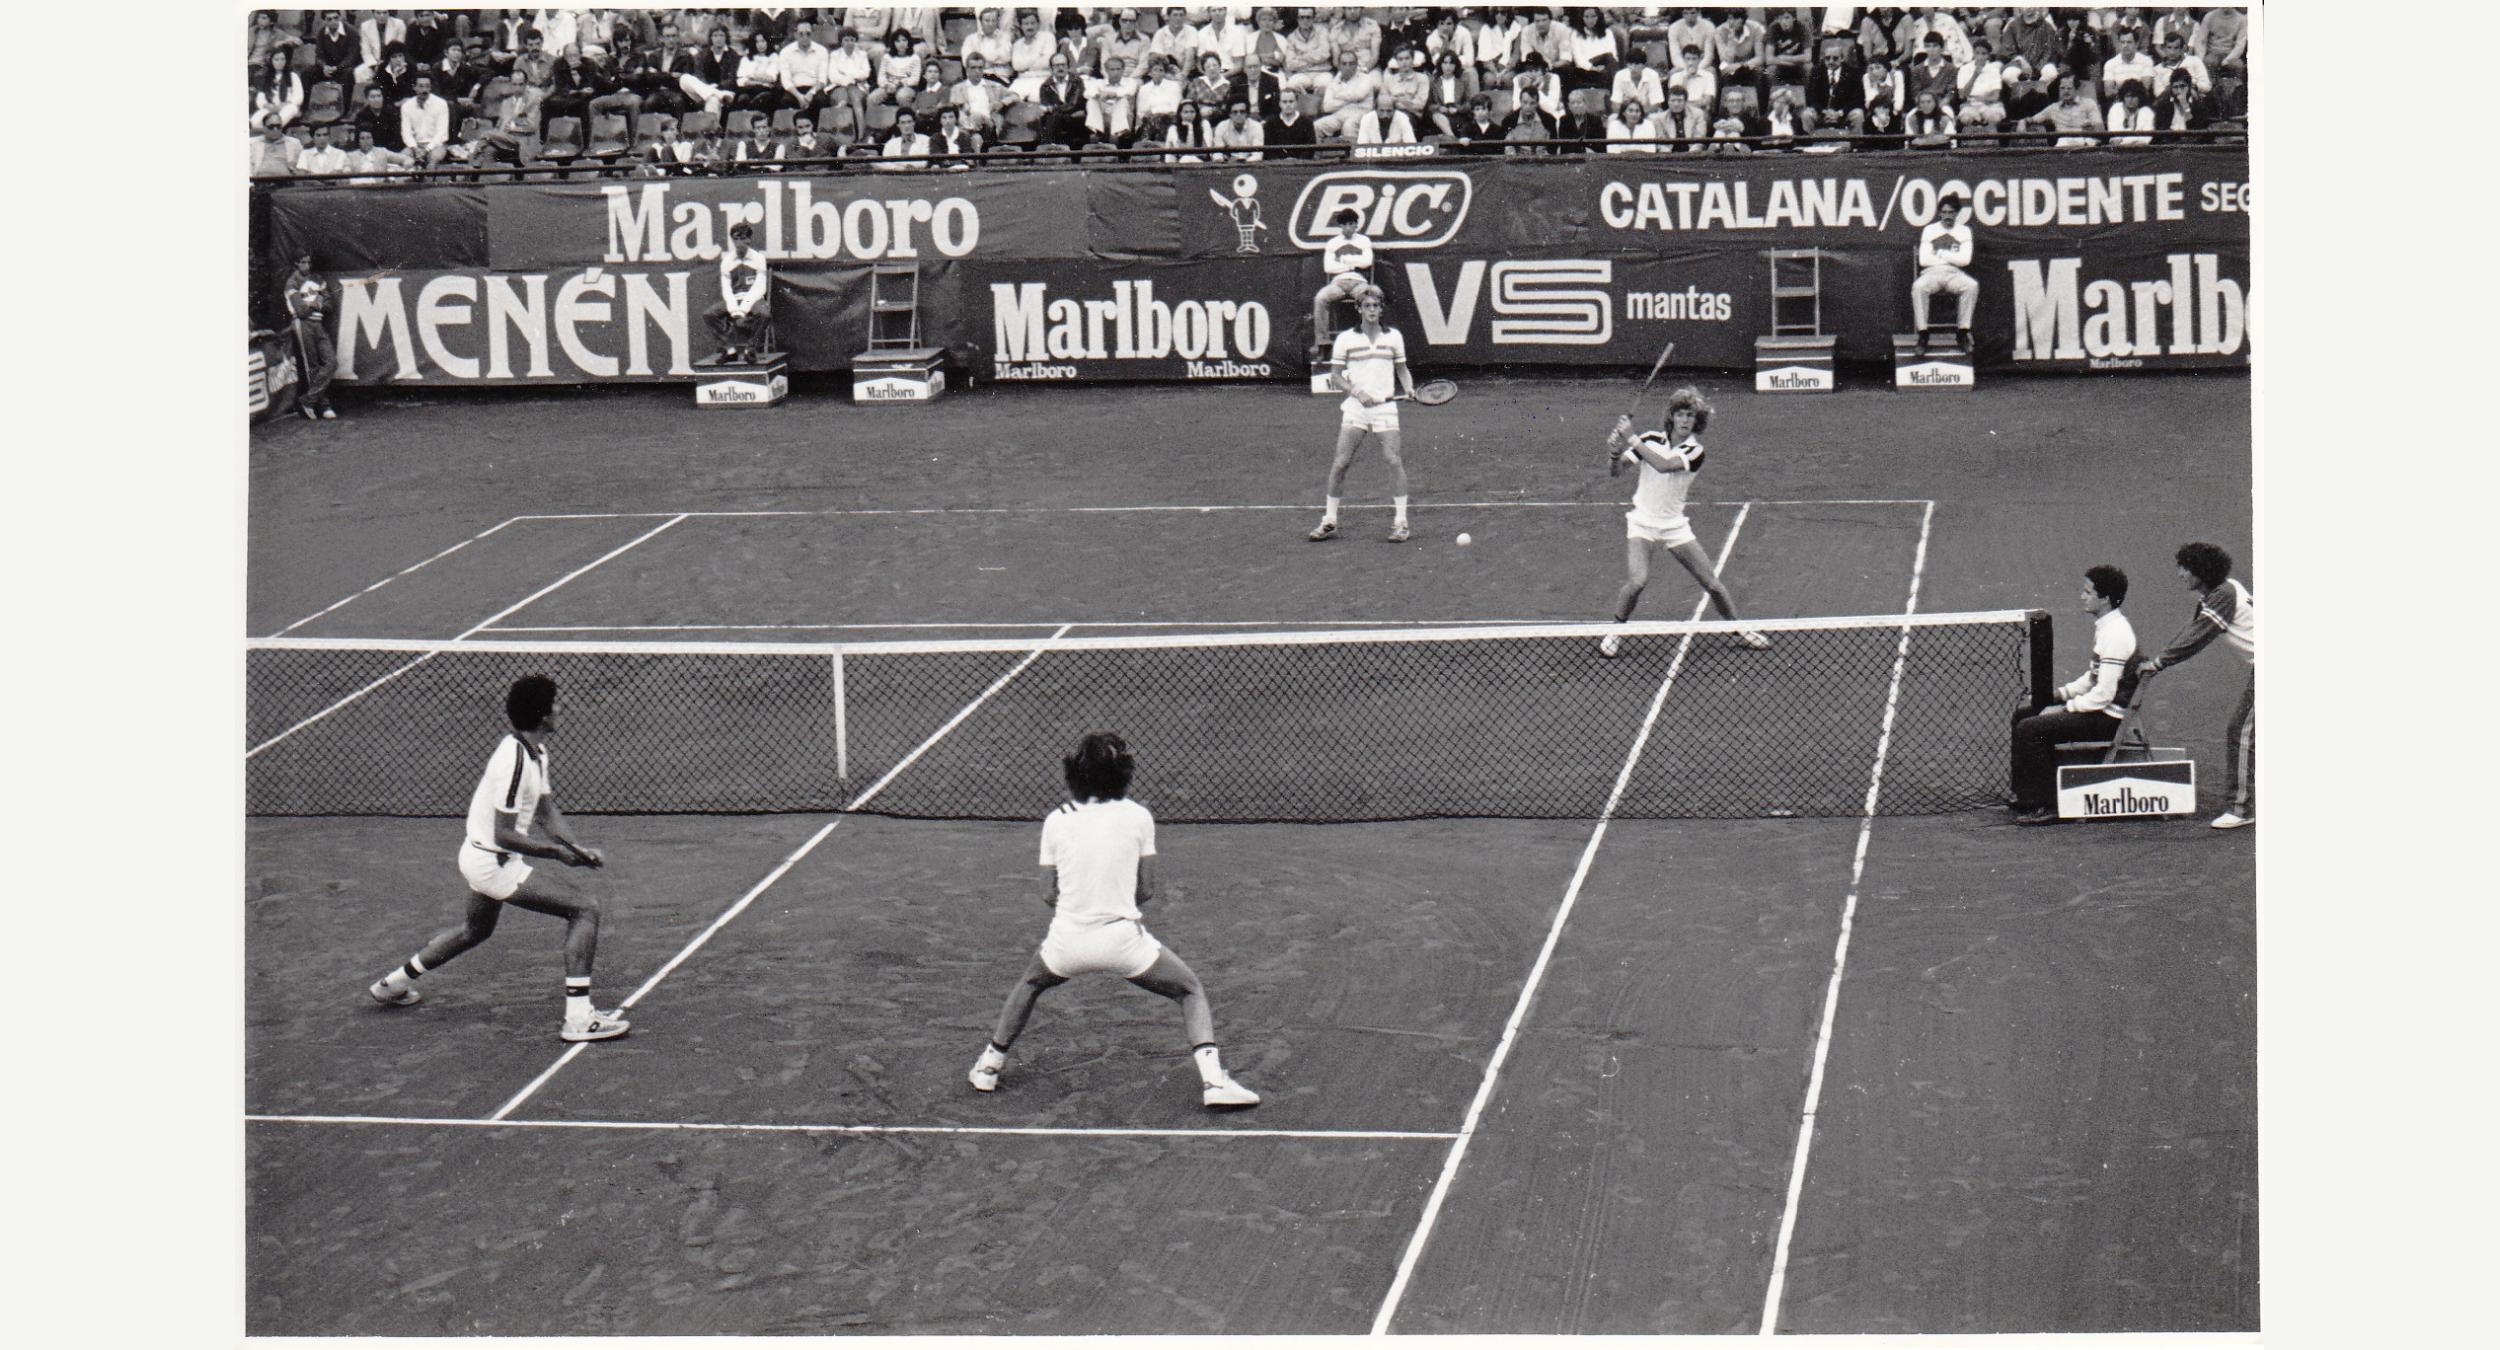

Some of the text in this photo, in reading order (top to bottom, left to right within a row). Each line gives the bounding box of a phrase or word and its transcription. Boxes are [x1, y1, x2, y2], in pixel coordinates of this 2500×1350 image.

[1354, 145, 1434, 158] SILENCIO
[601, 179, 980, 262] Marlboro
[1404, 259, 1731, 345] VS mantas
[2008, 253, 2249, 360] Marlb
[991, 280, 1271, 361] Marlboro
[994, 363, 1077, 379] Marlboro
[1187, 361, 1270, 378] Marlboro
[2089, 357, 2143, 369] Marlboro
[1769, 372, 1820, 388] Marlboro
[1909, 368, 1961, 384] Marlboro
[708, 386, 756, 401] Marlboro
[866, 383, 915, 399] Marlboro
[2083, 787, 2169, 816] Marlboro
